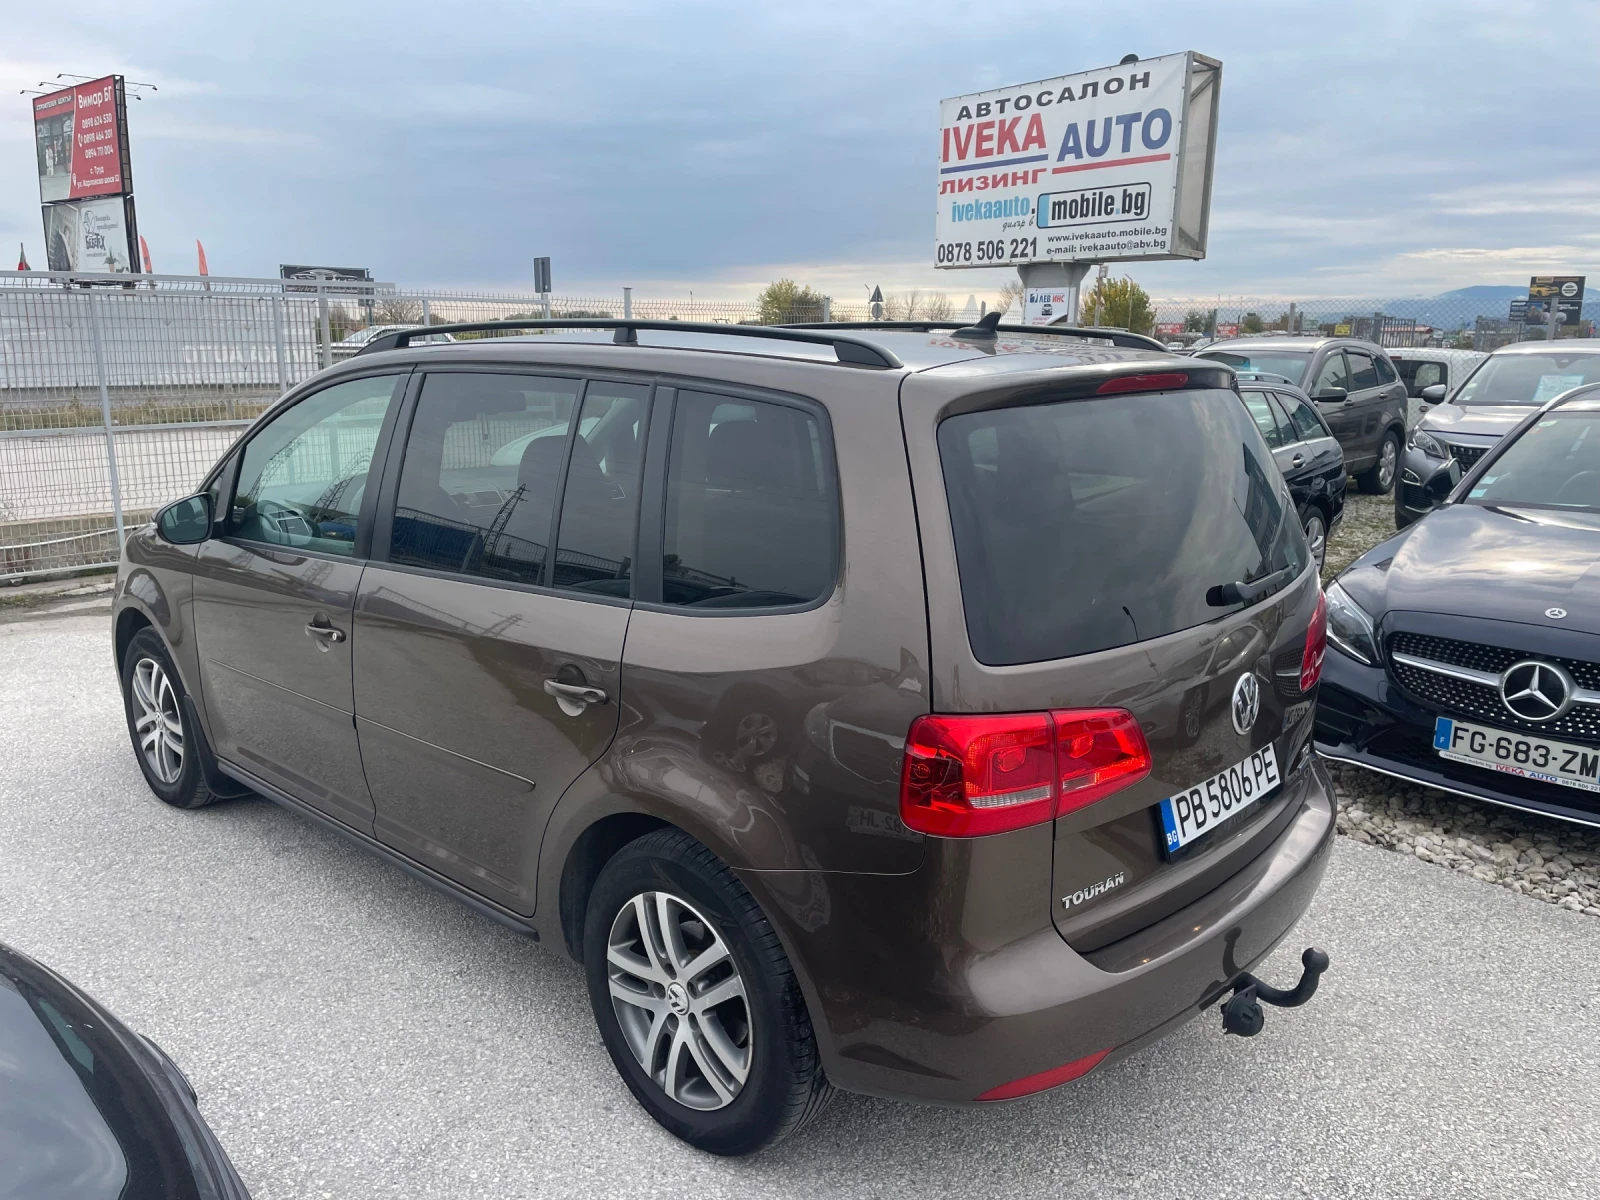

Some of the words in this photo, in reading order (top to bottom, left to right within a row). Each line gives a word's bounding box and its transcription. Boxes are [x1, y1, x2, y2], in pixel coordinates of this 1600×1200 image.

[78, 92, 103, 109] Вимар
[103, 85, 112, 102] БГ
[956, 71, 1151, 121] АВТОСАЛОН
[942, 112, 1047, 163] IVEKA
[1056, 107, 1173, 162] AUTO
[940, 168, 1047, 195] ЛИЗИНГ
[1051, 188, 1146, 221] mobile.bg
[1046, 245, 1077, 255] e-mail:
[1079, 239, 1166, 253] ivekaauto@abv.bg
[1047, 226, 1167, 243] www.ivekaauto.mobile.bg
[937, 242, 972, 264] 0878
[977, 239, 1005, 261] 506
[1009, 236, 1038, 259] 221
[1039, 294, 1051, 303] ЛЕВ
[1052, 294, 1065, 303] ИНС
[1451, 726, 1600, 779] FG-683-ZM
[1496, 764, 1525, 776] IVEKA
[1529, 772, 1558, 782] AUTO
[1167, 830, 1178, 846] BG
[1061, 871, 1124, 909] TOURAN
